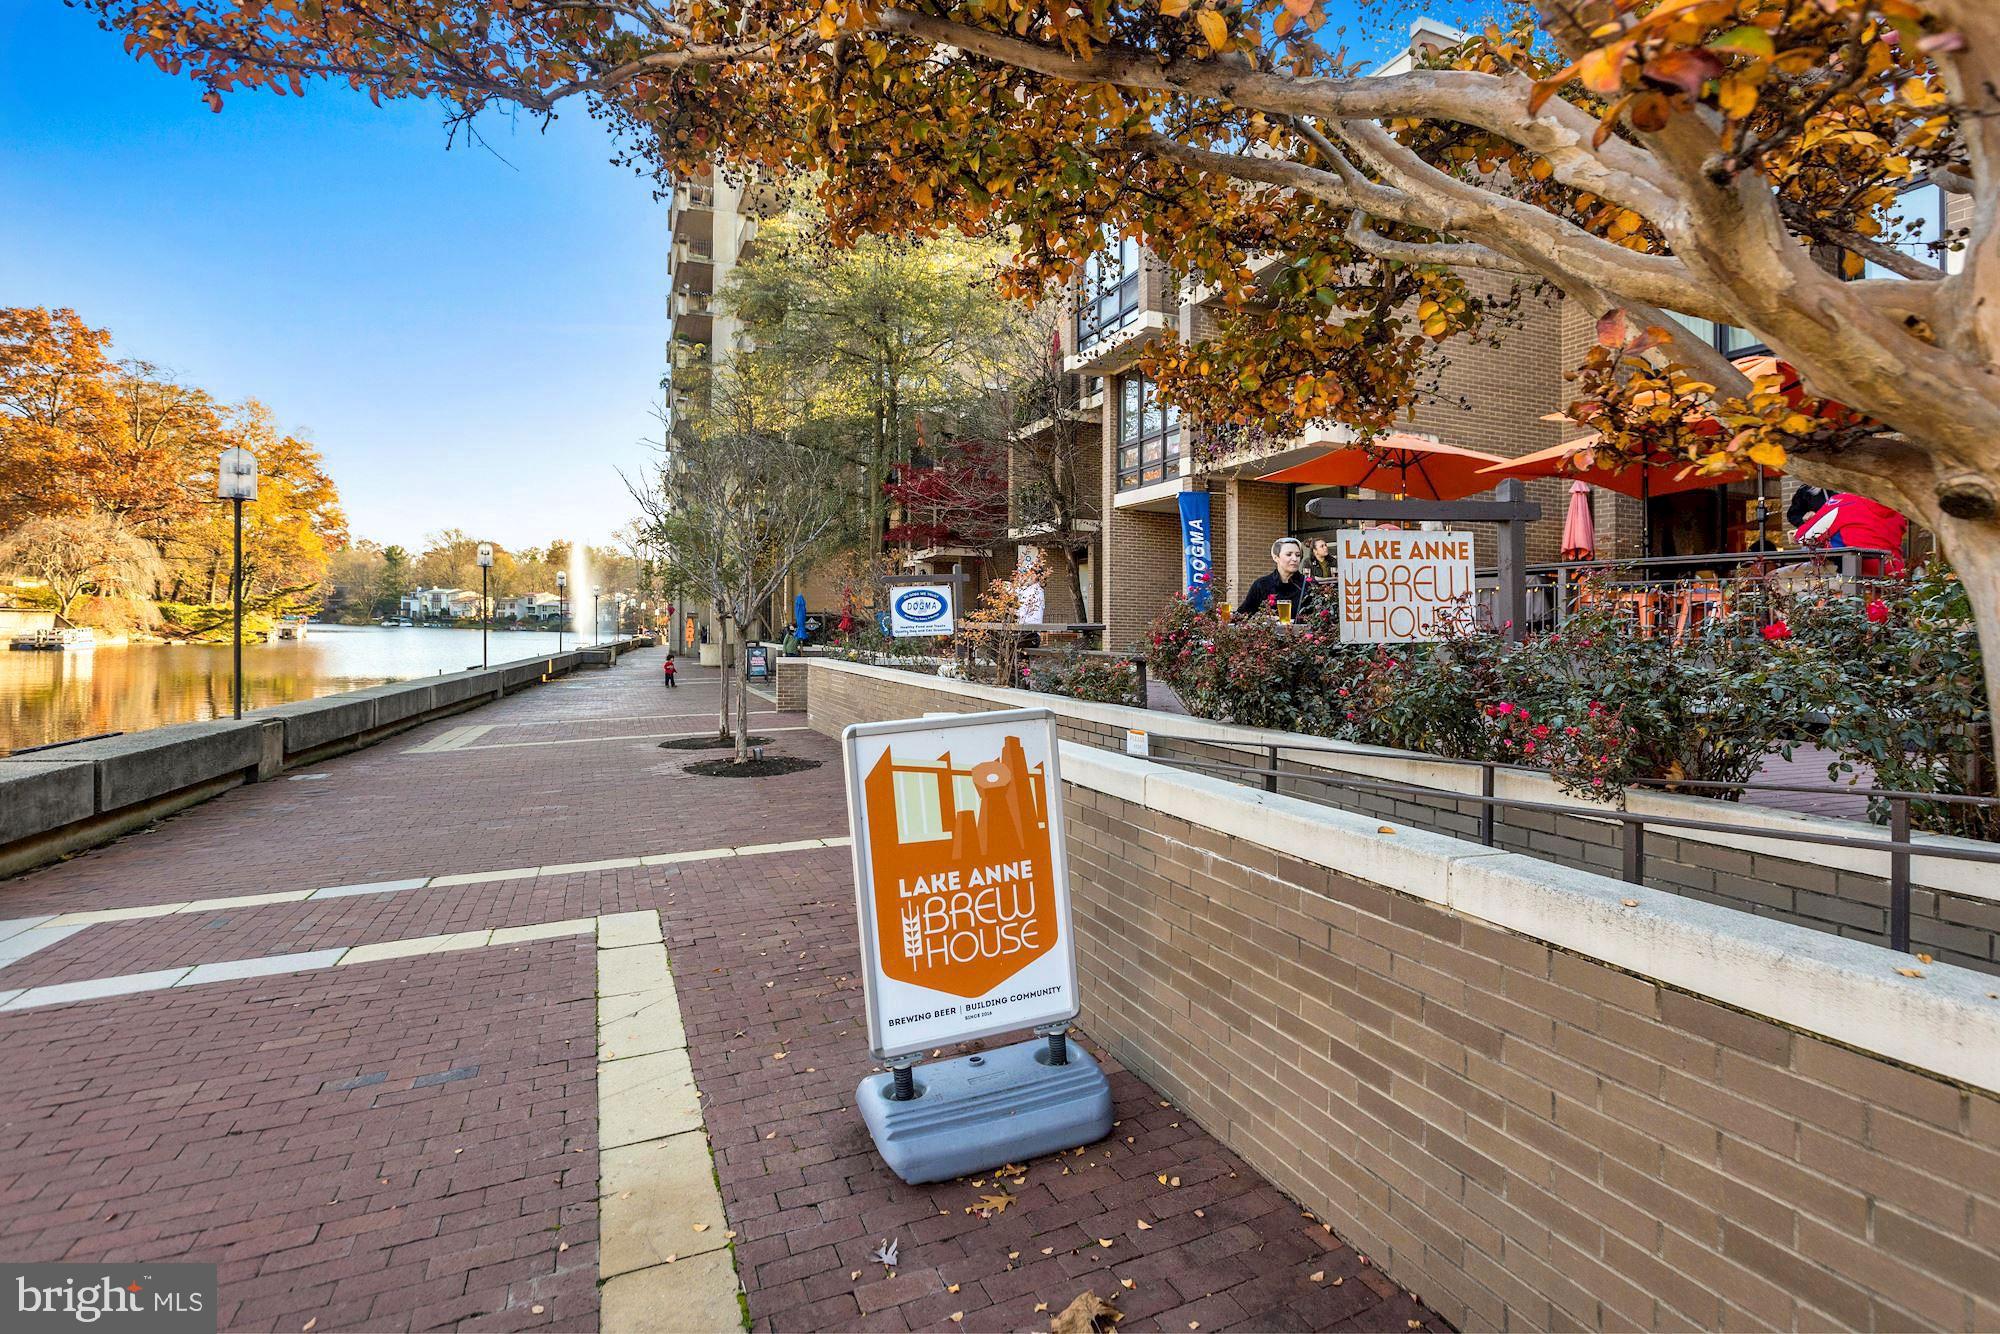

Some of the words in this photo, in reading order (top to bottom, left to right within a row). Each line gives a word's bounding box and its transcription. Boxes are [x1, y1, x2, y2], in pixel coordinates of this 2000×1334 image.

[1189, 519, 1206, 584] DOGMA
[1345, 540, 1402, 560] LAKE
[1409, 541, 1469, 560] ANNE
[1366, 565, 1470, 602] BREW
[906, 602, 937, 610] DOGMA
[899, 870, 961, 898] LAKE
[968, 859, 1033, 889] ANNE
[923, 881, 1036, 934] BREW
[924, 919, 1039, 968] HOUSE
[888, 1012, 932, 1027] BREWING
[934, 1007, 956, 1018] BEER
[965, 995, 1008, 1012] BUILDING
[1010, 985, 1062, 1002] COMMUNITY
